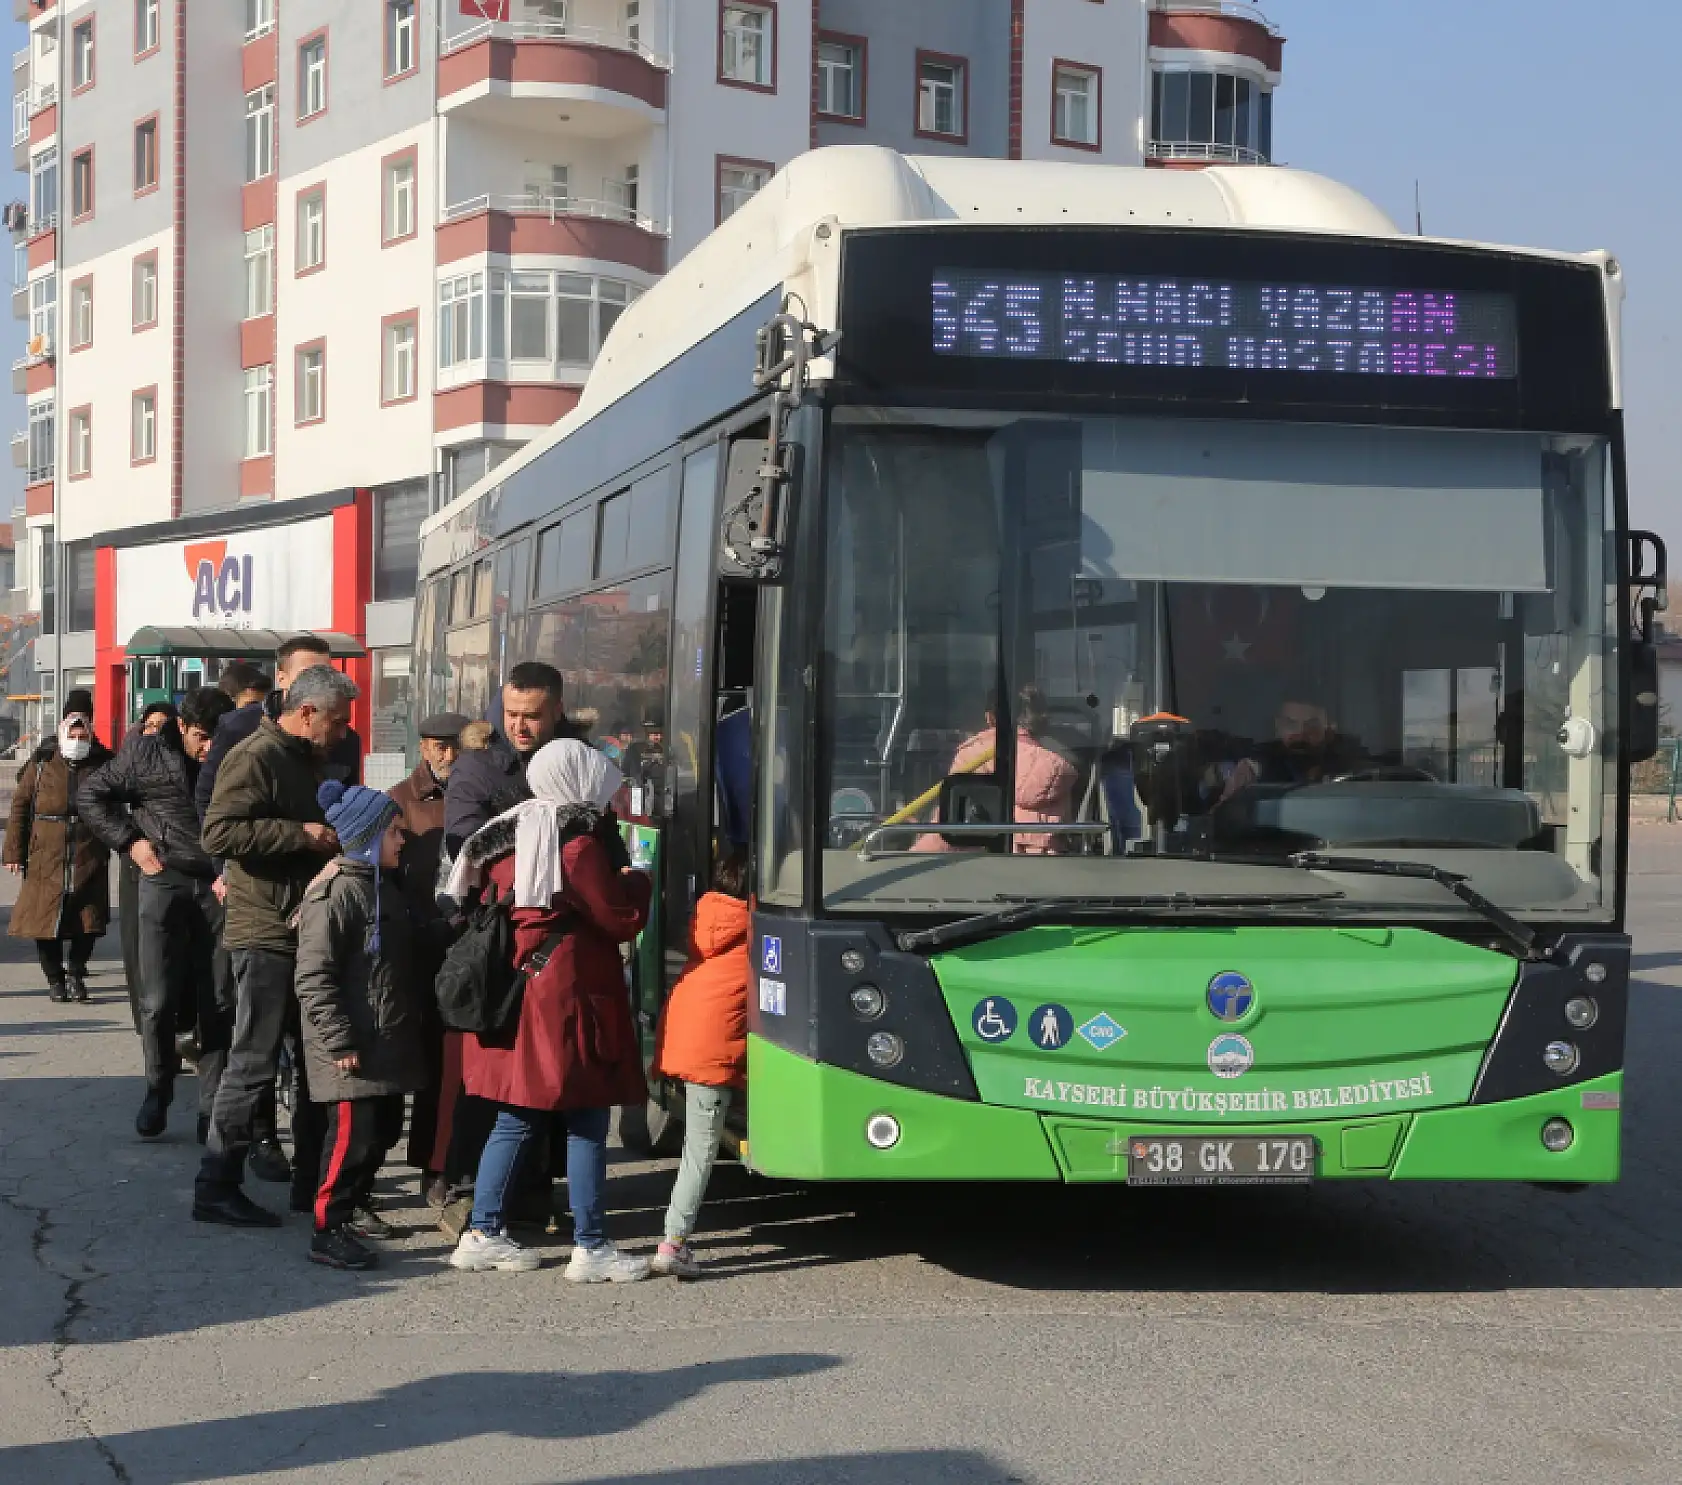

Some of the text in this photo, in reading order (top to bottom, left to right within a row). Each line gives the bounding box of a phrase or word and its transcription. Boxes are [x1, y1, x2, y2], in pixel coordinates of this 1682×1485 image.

[1024, 1071, 1434, 1117] KAYSERİ BÜYÜKŞEHİR BELEDİYESİ
[1147, 1140, 1307, 1172] 38 GK 170
